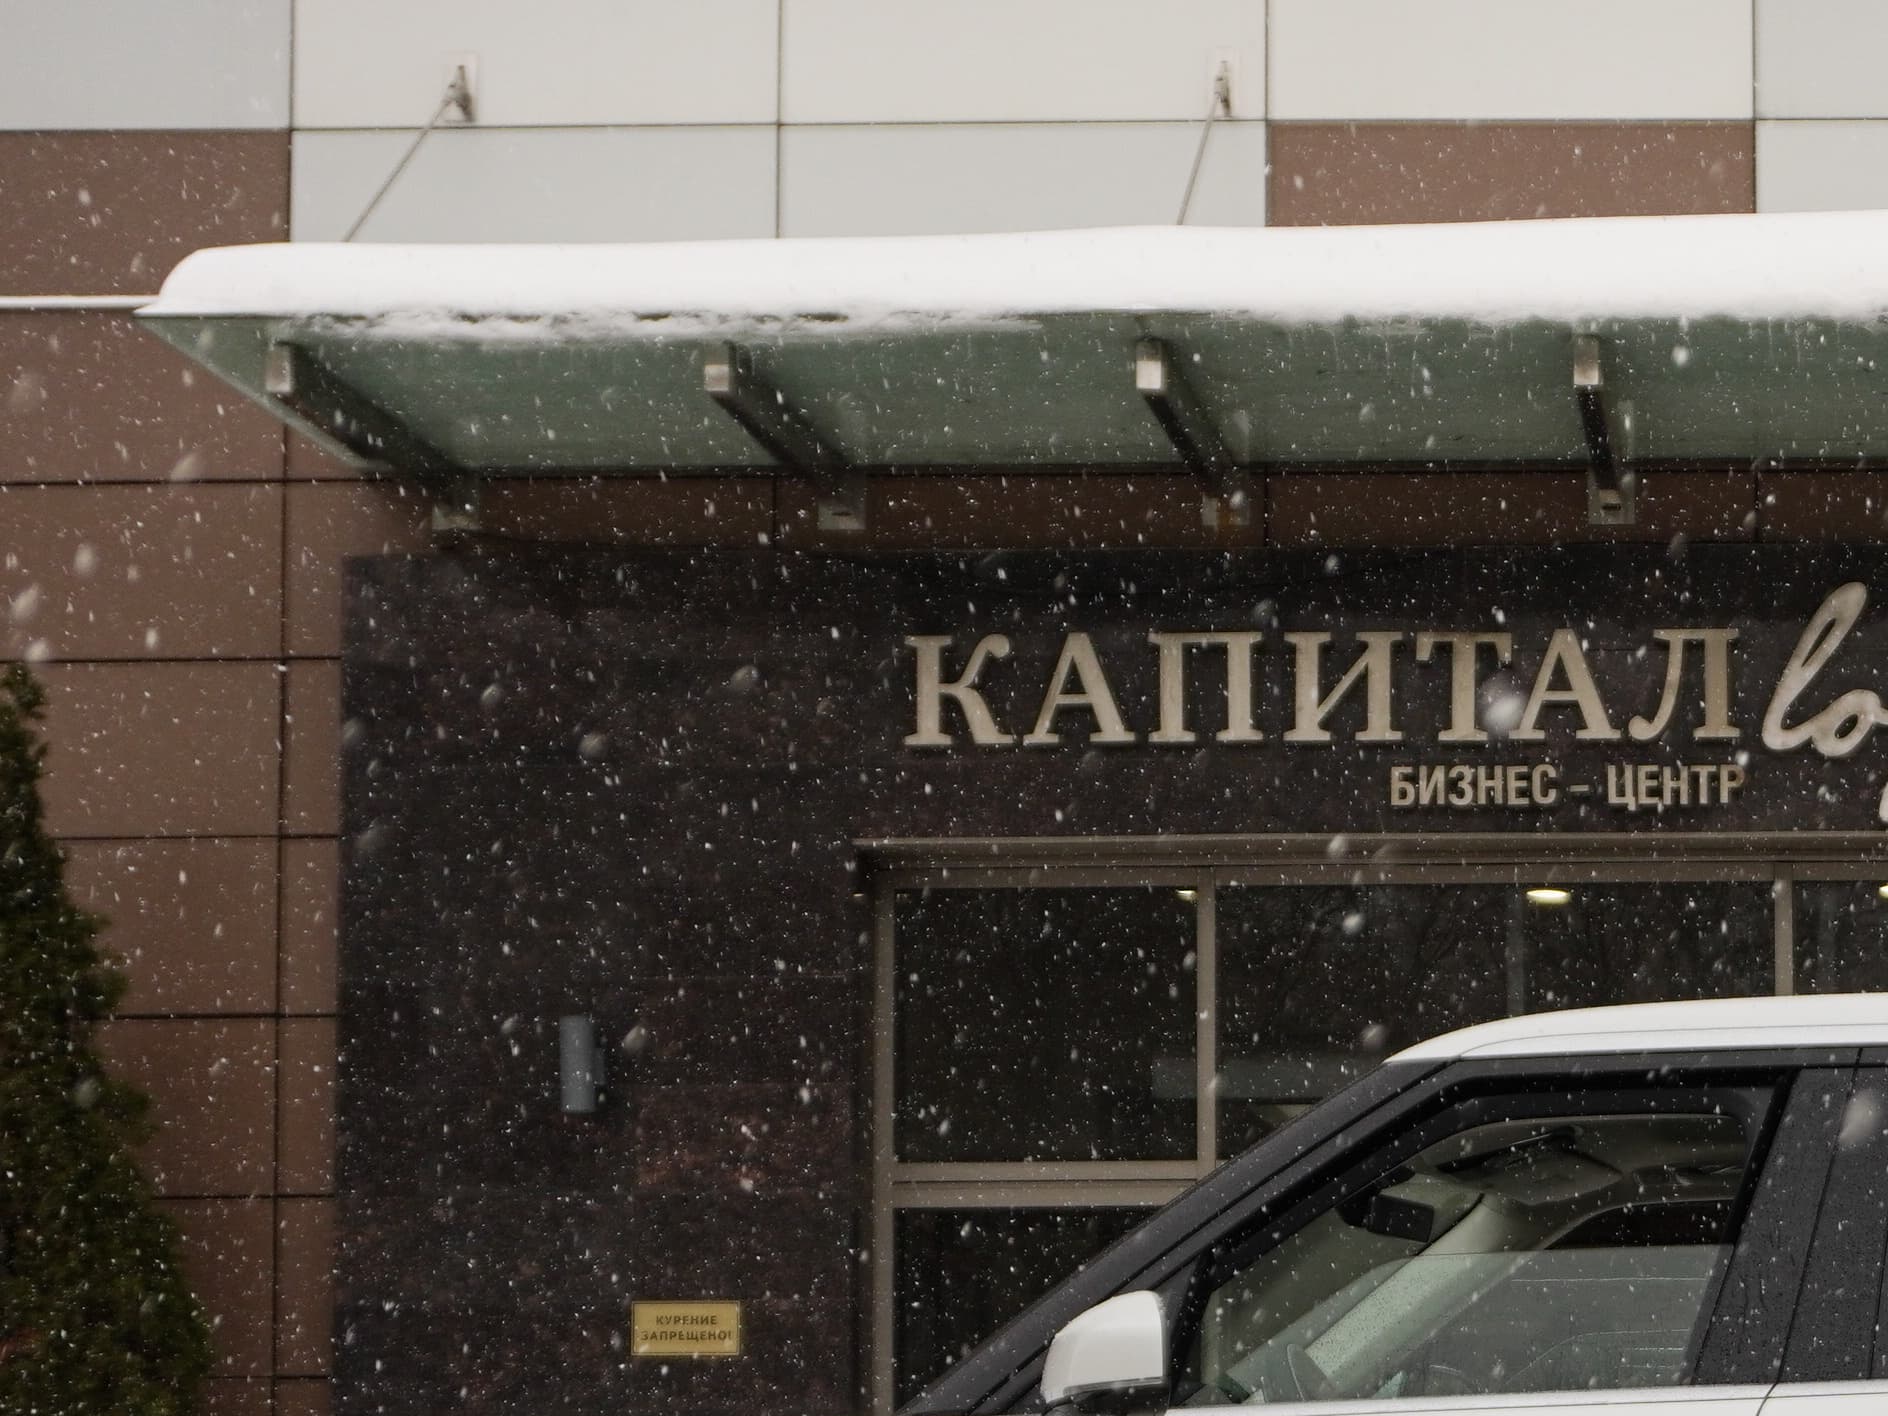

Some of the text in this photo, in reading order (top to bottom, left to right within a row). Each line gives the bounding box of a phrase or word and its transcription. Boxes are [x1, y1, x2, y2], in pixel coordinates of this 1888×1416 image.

[904, 629, 1741, 745] КАПИТАЛ
[1390, 764, 1557, 806] БИЗНЕС
[1607, 764, 1745, 811] ЦЕНТР
[656, 1315, 718, 1325] КУРЕНИЕ
[641, 1330, 732, 1343] ЗАПРЕЩЕНО!
